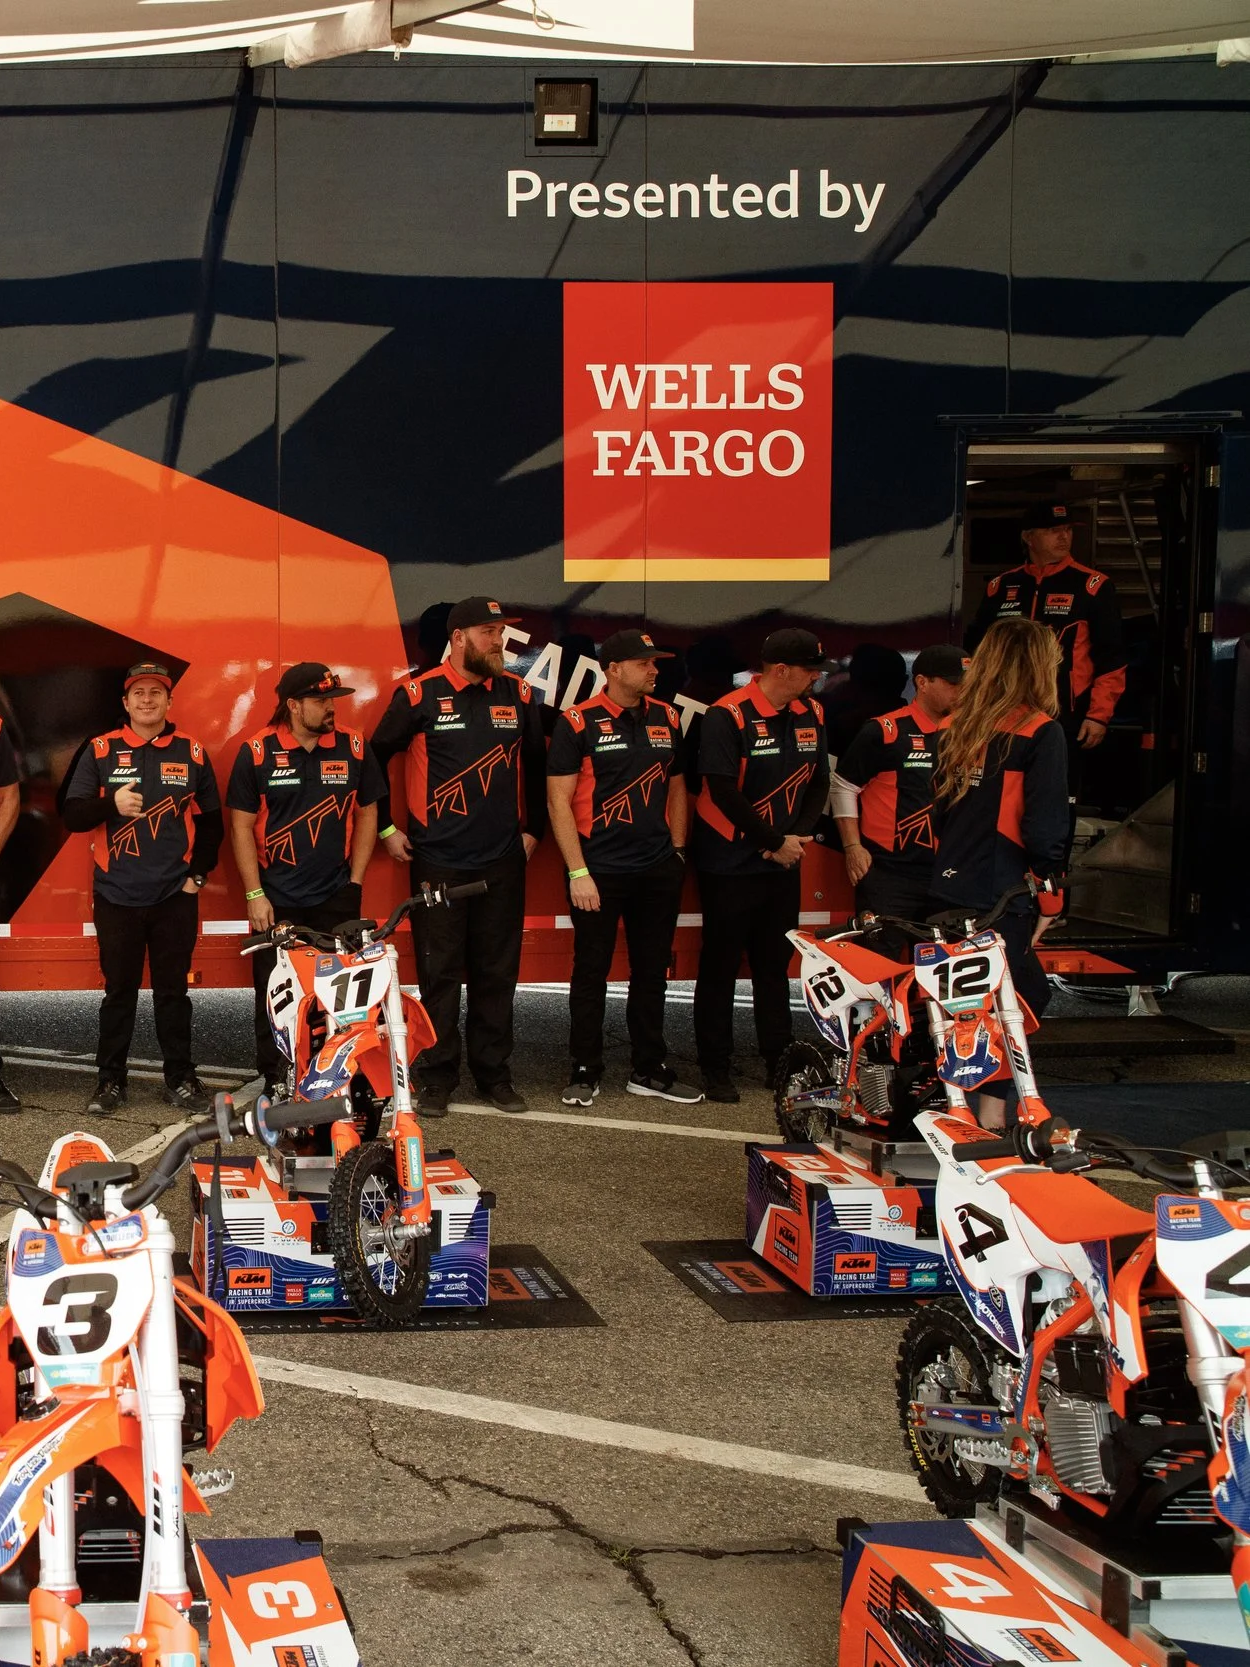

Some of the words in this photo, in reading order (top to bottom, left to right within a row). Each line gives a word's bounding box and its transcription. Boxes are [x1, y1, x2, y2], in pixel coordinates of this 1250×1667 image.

[506, 169, 800, 219] Presented
[819, 169, 886, 233] by
[585, 363, 806, 411] WELLS
[592, 429, 805, 478] FARGO
[330, 968, 374, 1013] 11
[933, 956, 991, 1001] 12
[953, 1066, 983, 1078] KTM
[410, 1144, 419, 1176] MOTOREX
[782, 1154, 830, 1170] 12
[926, 1132, 950, 1156] DUNLOP
[400, 1141, 408, 1187] DUNLOP
[774, 1239, 789, 1257] RACING
[788, 1249, 798, 1264] TEAM
[778, 1225, 796, 1246] KTM
[954, 1202, 1009, 1263] 4
[234, 1273, 266, 1284] KTM
[834, 1273, 858, 1281] RACING
[841, 1257, 872, 1268] KTM
[37, 1273, 119, 1355] 3
[976, 1299, 1007, 1338] MOTOREX
[909, 1429, 927, 1467] DUNLO
[247, 1581, 317, 1619] 3
[929, 1562, 1014, 1604] 4
[1031, 1632, 1064, 1658] KTM
